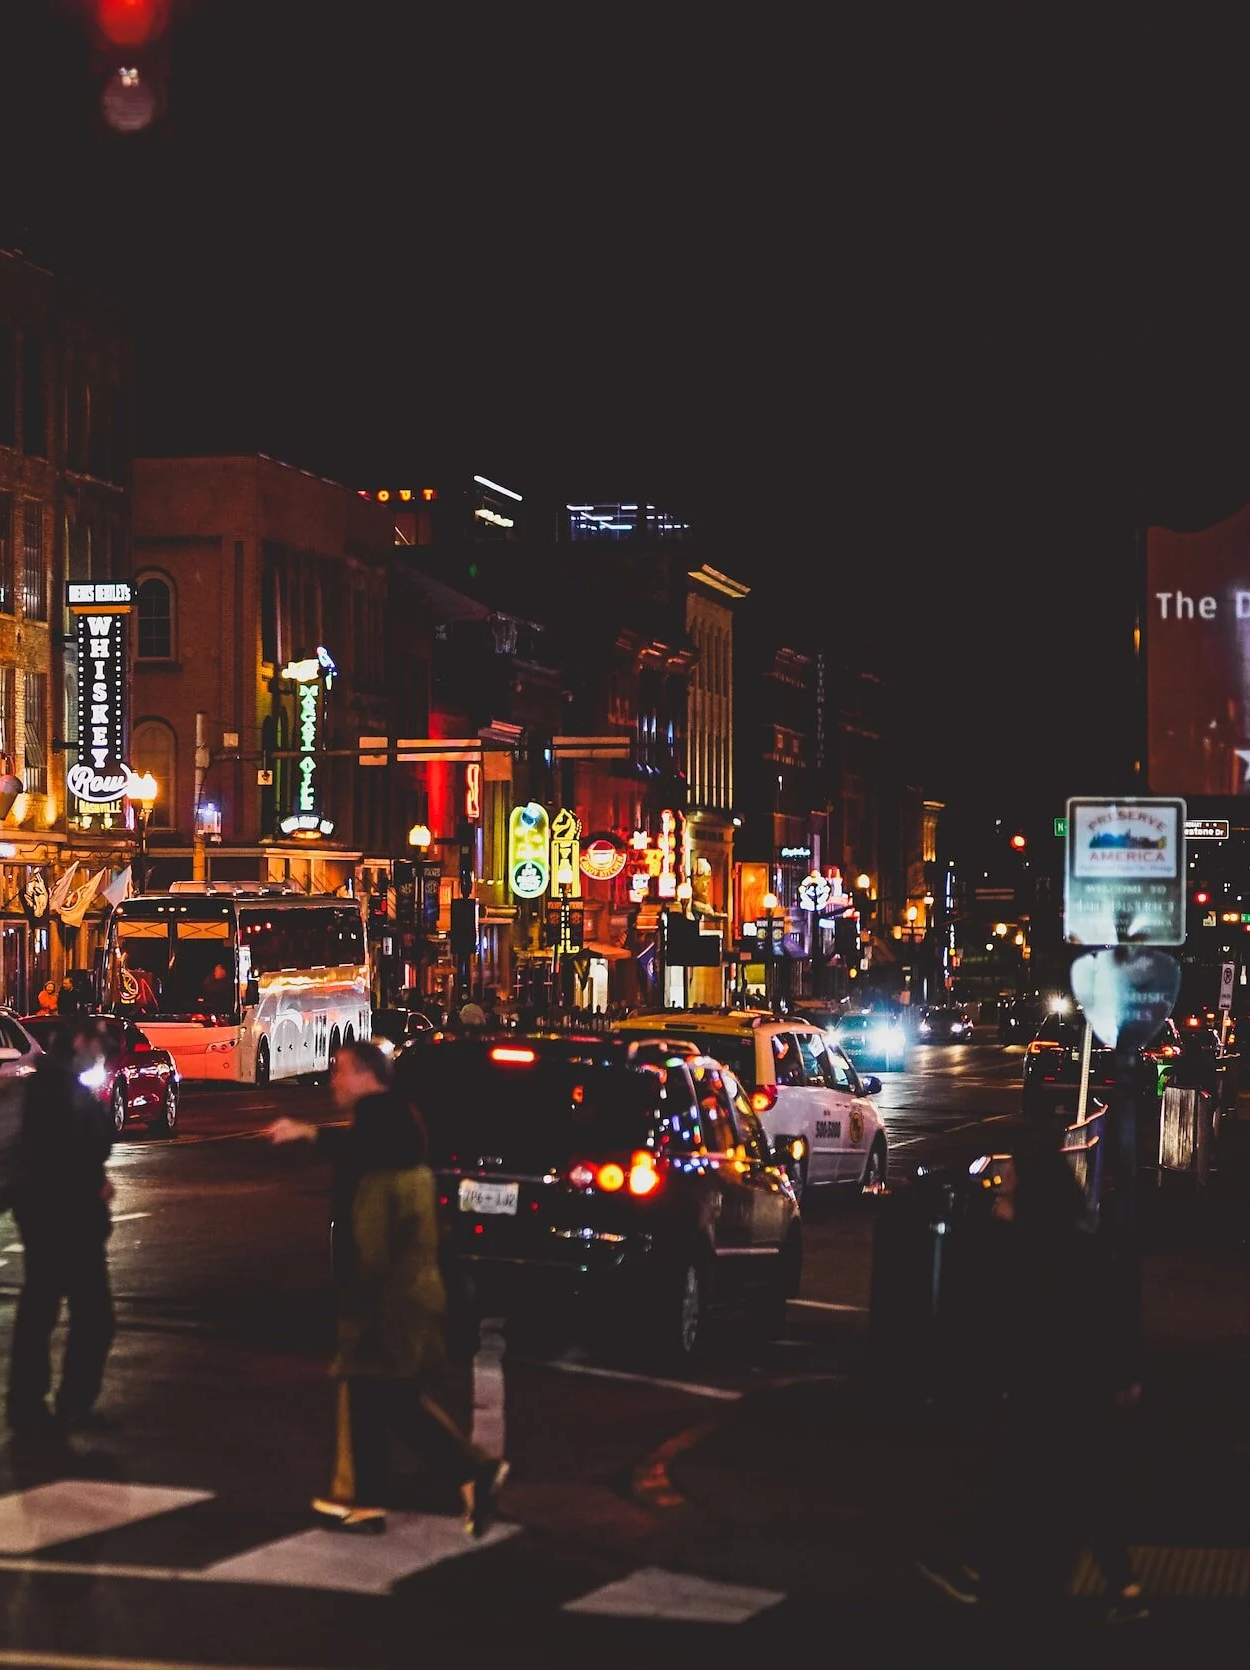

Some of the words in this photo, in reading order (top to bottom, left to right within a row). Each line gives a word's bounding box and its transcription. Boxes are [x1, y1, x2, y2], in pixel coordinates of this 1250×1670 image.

[1155, 591, 1217, 619] The
[87, 616, 113, 768] WHISKEY
[72, 765, 126, 799] Row
[1183, 828, 1214, 836] estone
[1090, 852, 1166, 862] AMERICA
